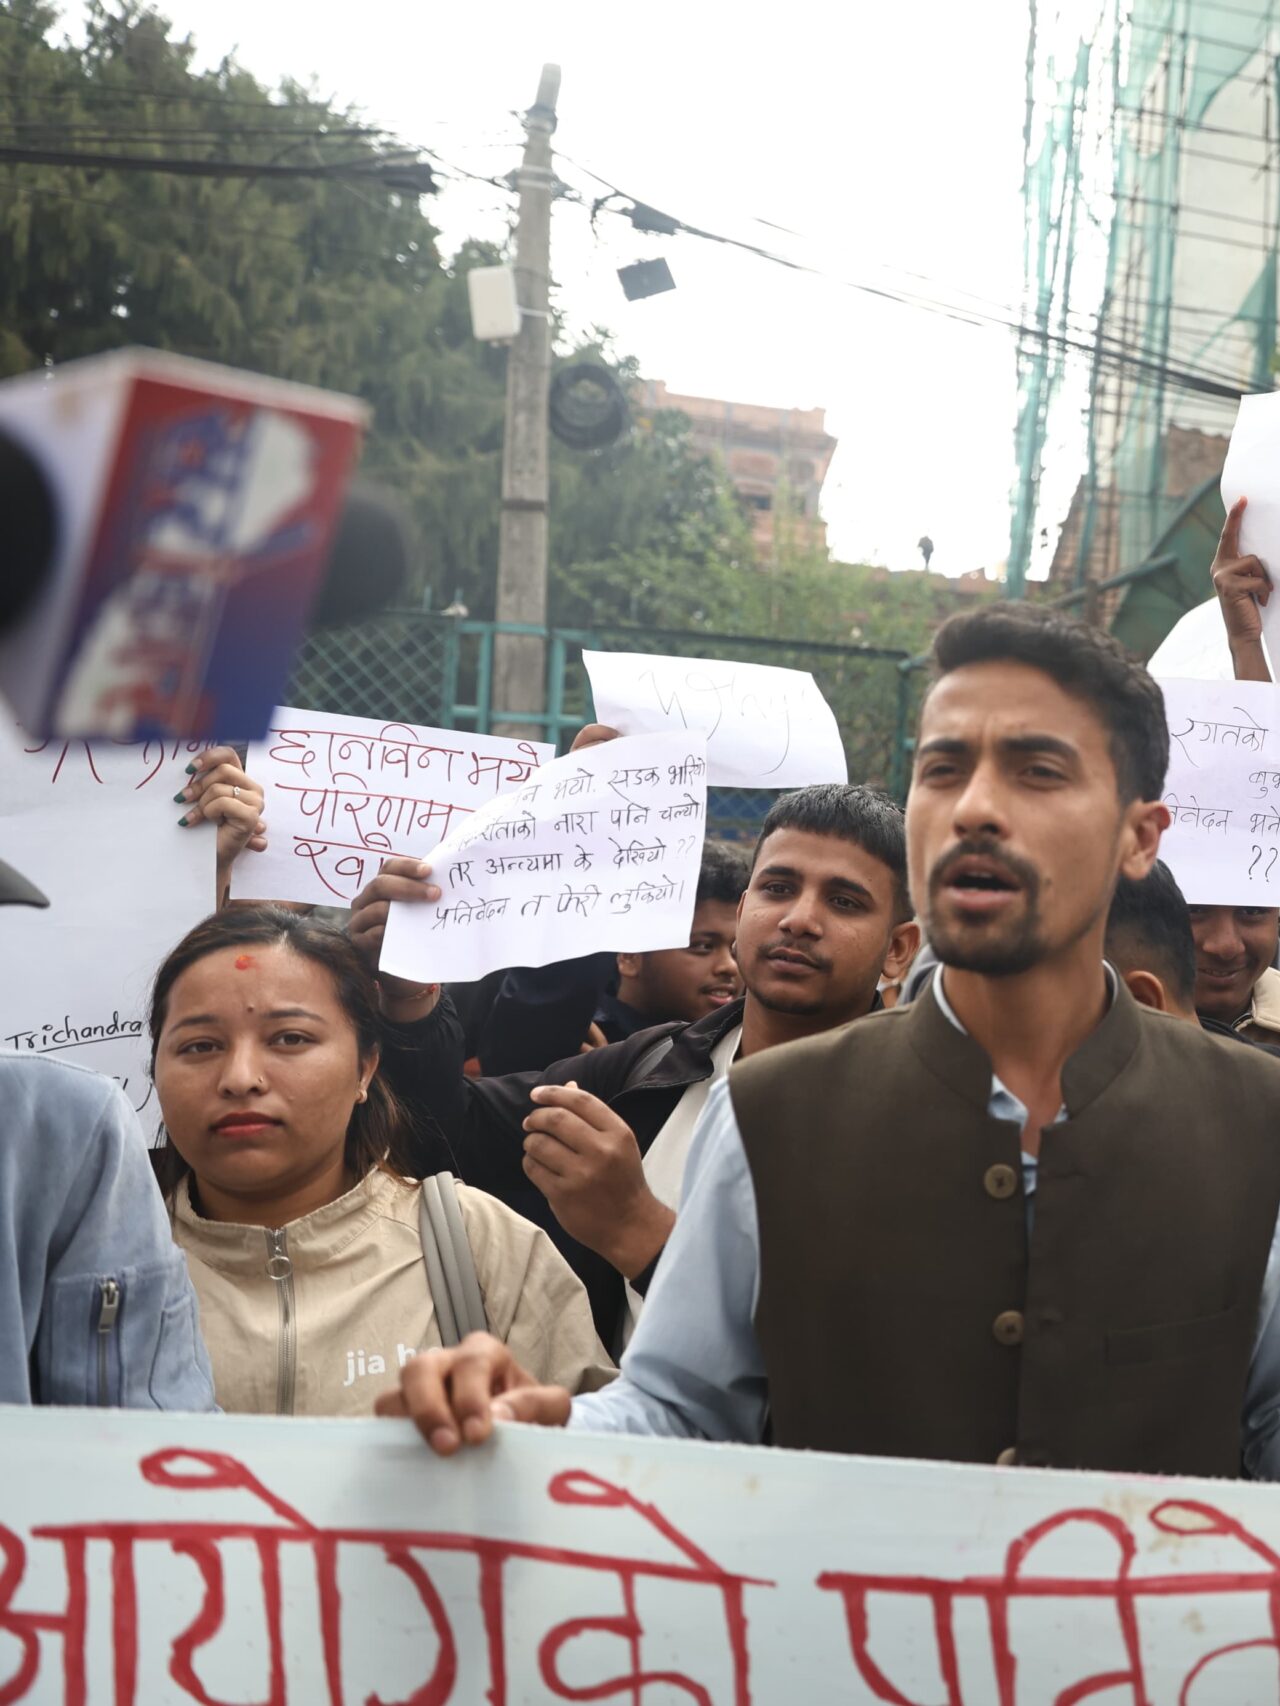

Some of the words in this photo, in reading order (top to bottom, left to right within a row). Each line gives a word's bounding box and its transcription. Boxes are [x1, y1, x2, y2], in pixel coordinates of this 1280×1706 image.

[1171, 706, 1269, 769] रगतको
[553, 811, 600, 836] नारा
[611, 802, 652, 826] पनि
[448, 860, 475, 889] तर
[573, 843, 595, 872] के
[520, 895, 552, 916] त
[4, 1010, 143, 1051] Trichandra
[343, 1350, 386, 1387] jia
